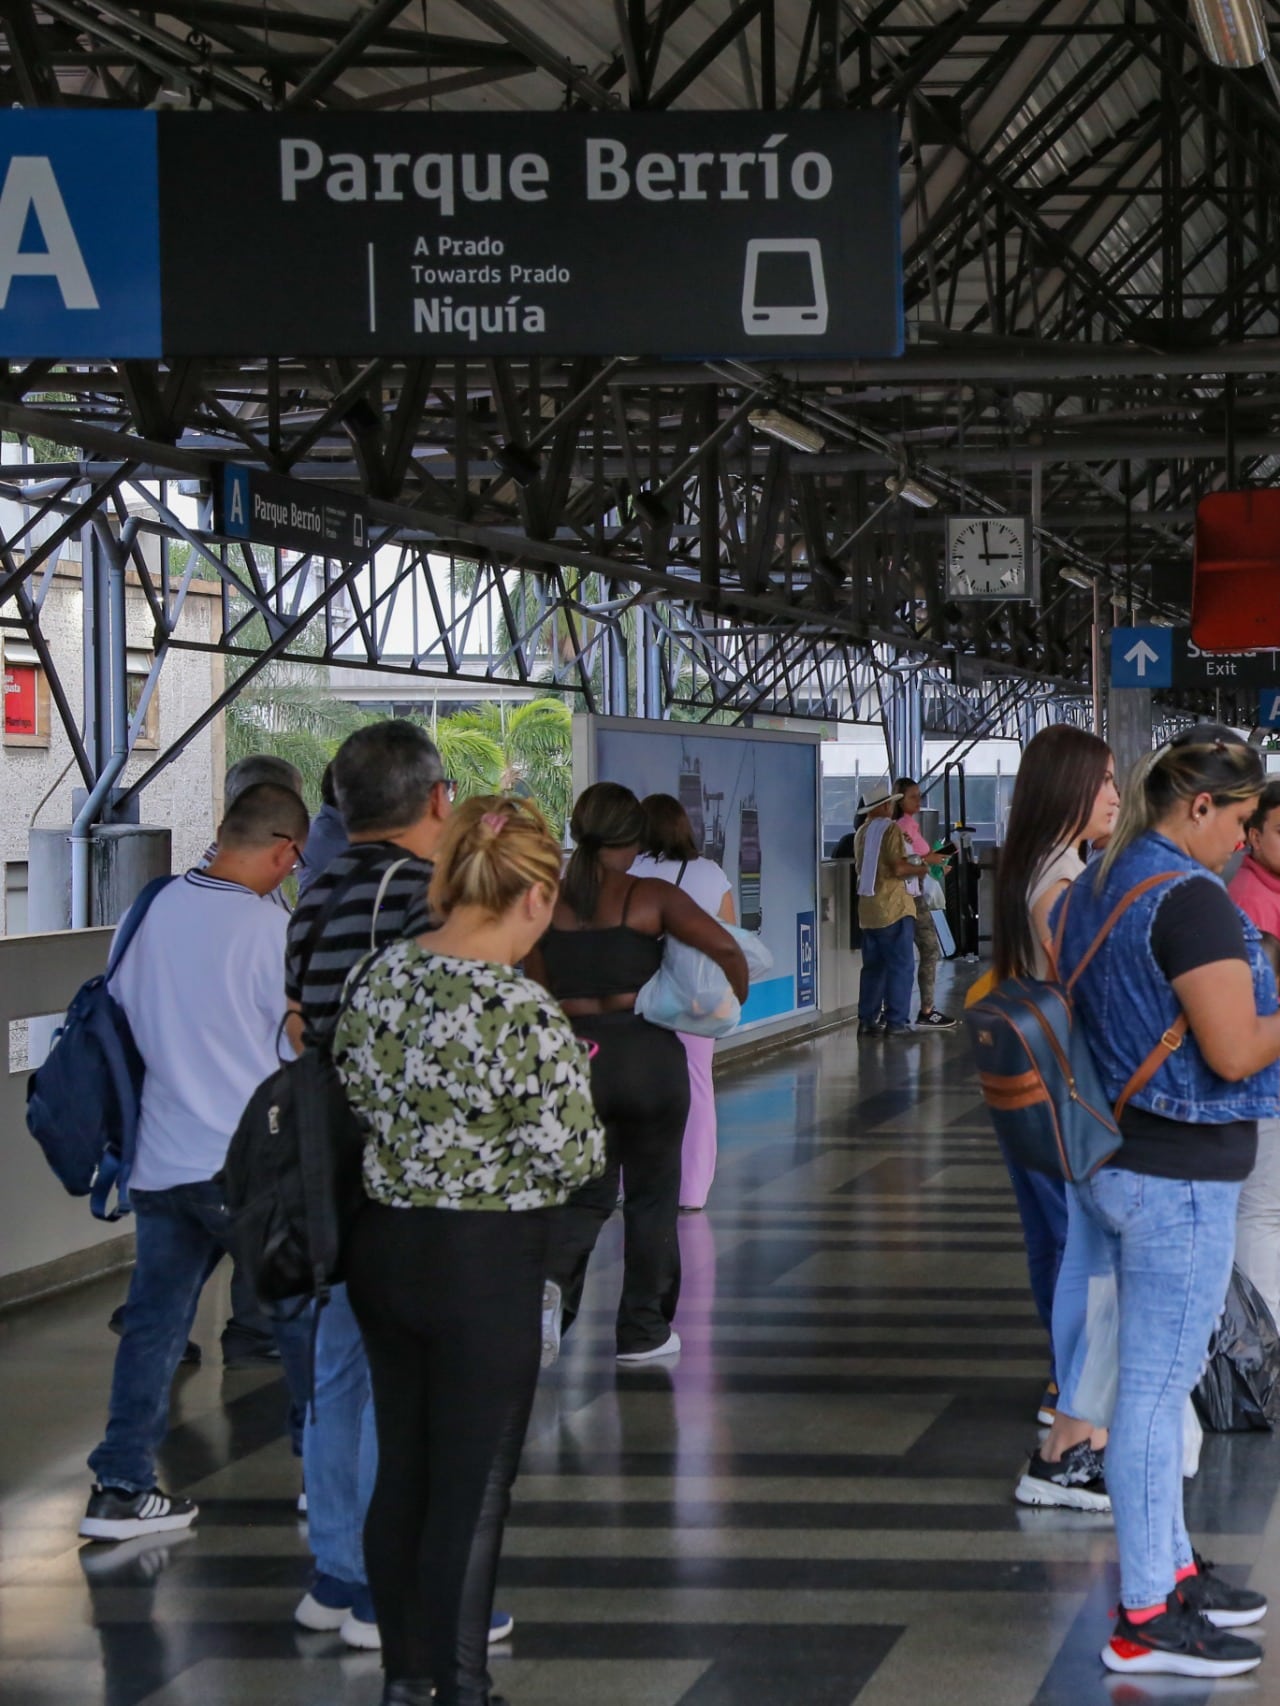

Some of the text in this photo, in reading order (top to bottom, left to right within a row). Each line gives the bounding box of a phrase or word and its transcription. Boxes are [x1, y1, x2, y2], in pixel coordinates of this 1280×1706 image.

[279, 133, 833, 216] Parque Berrío
[0, 156, 100, 309] A
[413, 236, 504, 256] A Prado
[411, 264, 570, 284] Towards Prado
[413, 296, 546, 341] Niquía
[230, 478, 244, 525] A
[255, 493, 321, 532] Parque Berrío
[1206, 661, 1237, 676] Exit
